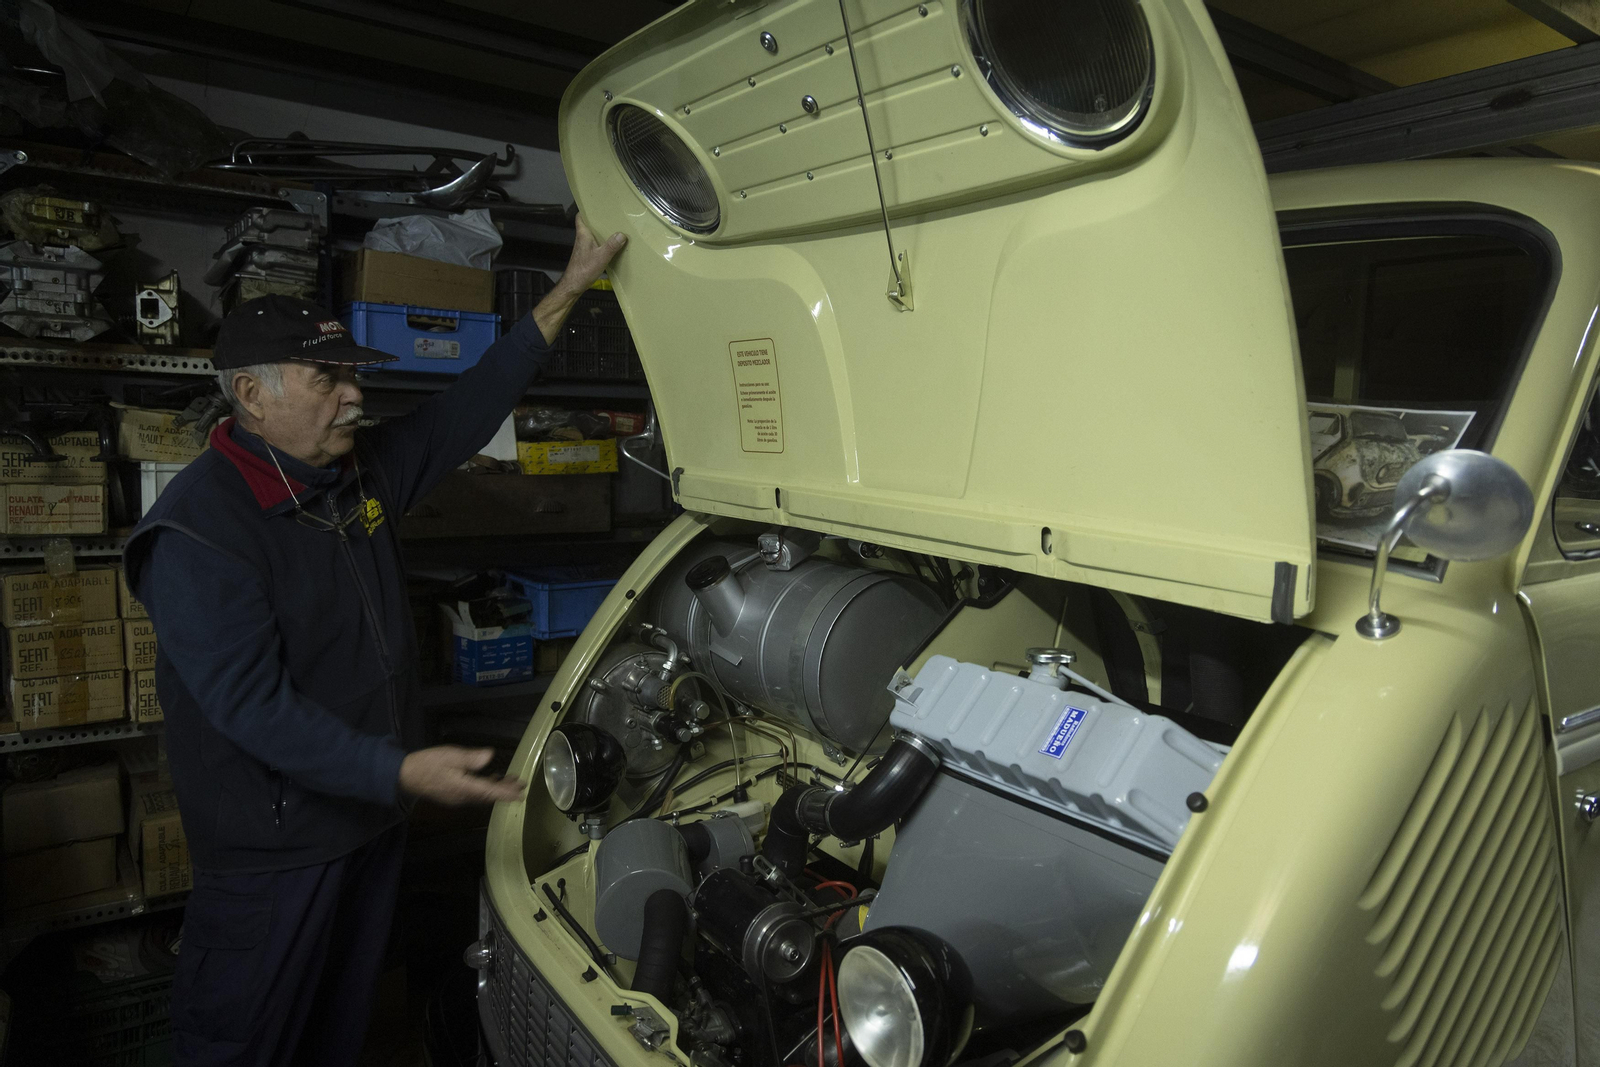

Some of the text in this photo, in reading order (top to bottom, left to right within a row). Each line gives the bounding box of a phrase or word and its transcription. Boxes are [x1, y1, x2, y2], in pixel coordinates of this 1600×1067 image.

[51, 436, 100, 447] DAPTABLE
[138, 433, 165, 445] NAULT
[9, 505, 45, 516] RENAULT
[12, 576, 111, 592] CULATA ADAPTABLE
[13, 597, 44, 613] SEAT
[17, 625, 116, 643] CULATA ADAPTABLE
[133, 626, 156, 636] CUL
[134, 641, 157, 656] SEA
[19, 647, 50, 664] SEAT
[139, 679, 156, 688] CUL
